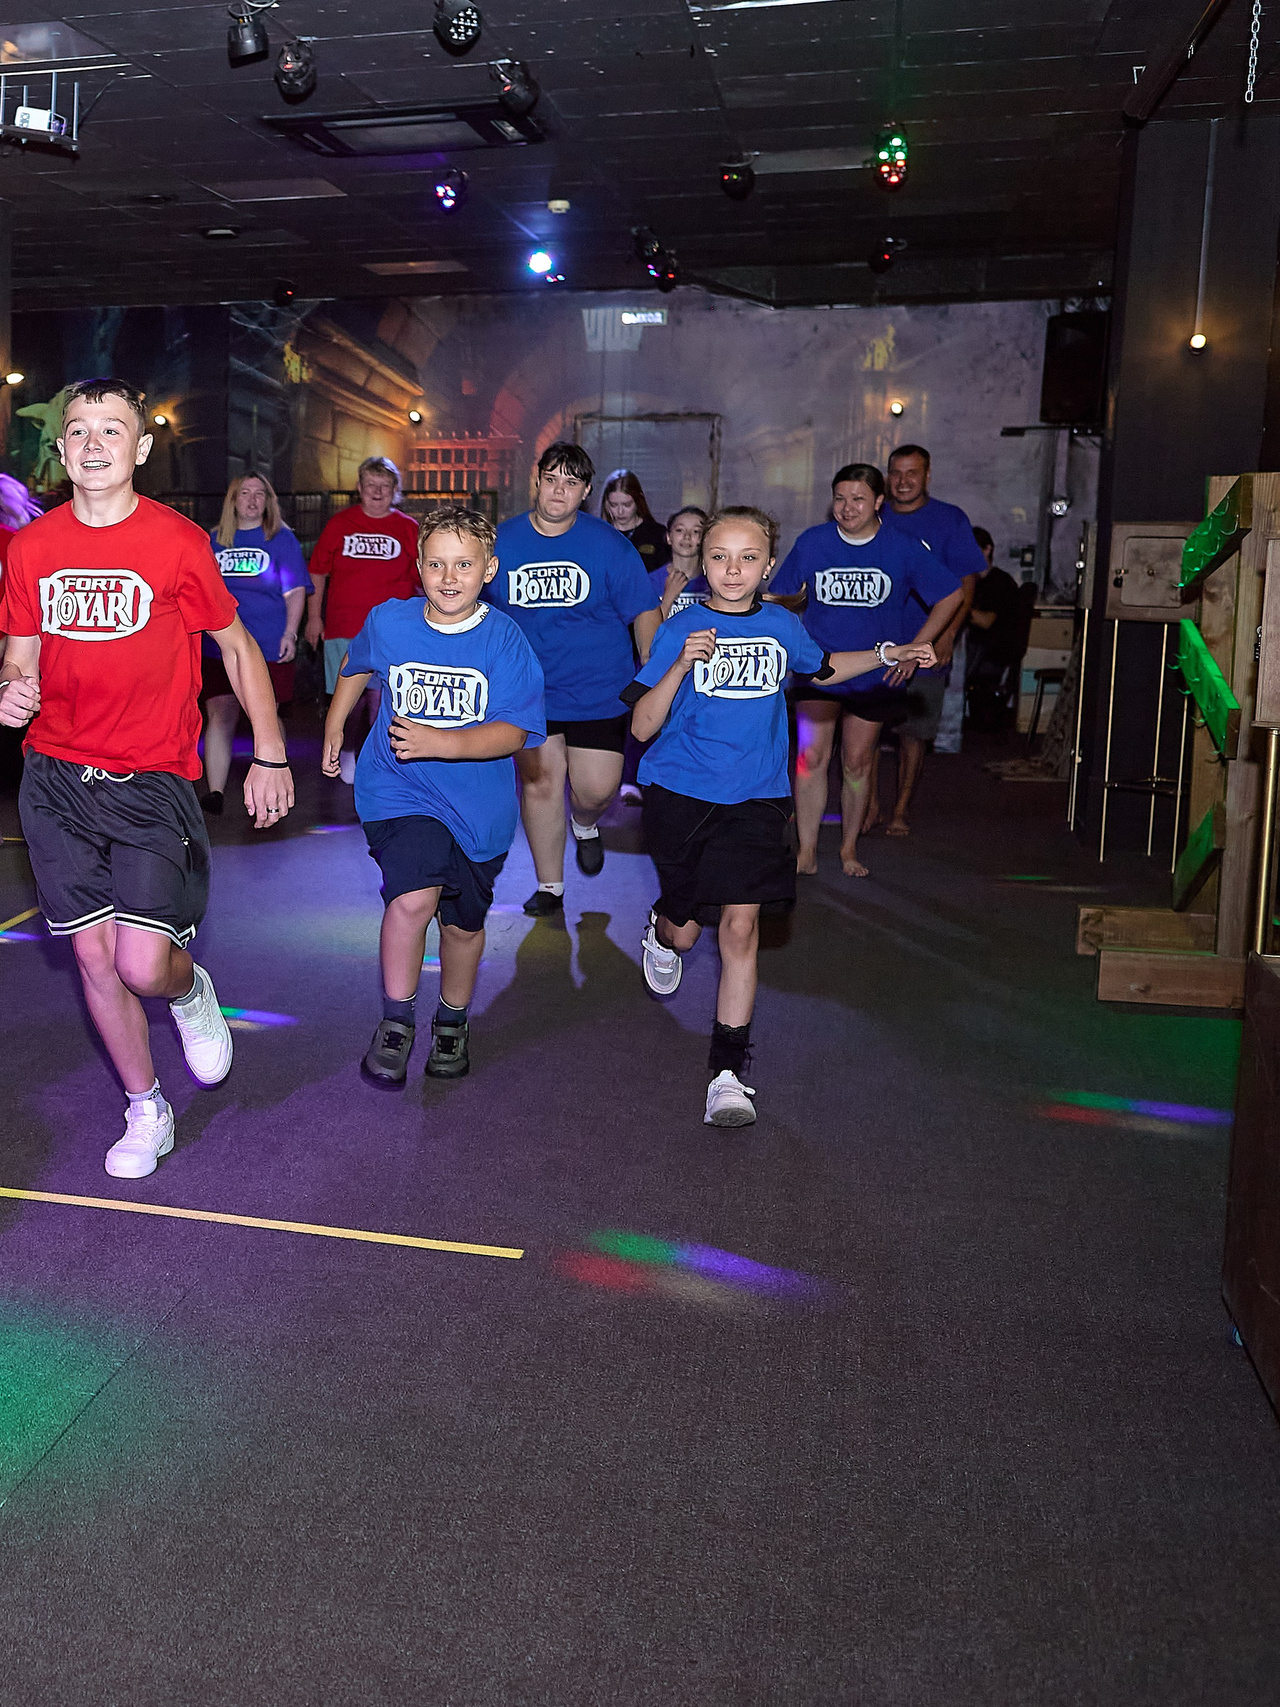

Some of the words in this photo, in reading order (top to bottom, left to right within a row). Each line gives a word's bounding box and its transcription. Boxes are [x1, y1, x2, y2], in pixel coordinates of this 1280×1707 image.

[342, 535, 401, 558] BOYARD
[528, 567, 567, 578] FORT
[834, 573, 871, 581] FORT
[64, 577, 121, 591] FORT
[508, 567, 590, 606] BOYARD
[815, 571, 892, 605] BOYARD
[38, 576, 154, 636] BOYARD
[719, 644, 766, 656] FORT
[413, 670, 466, 687] FORT
[388, 665, 489, 723] BOYARD
